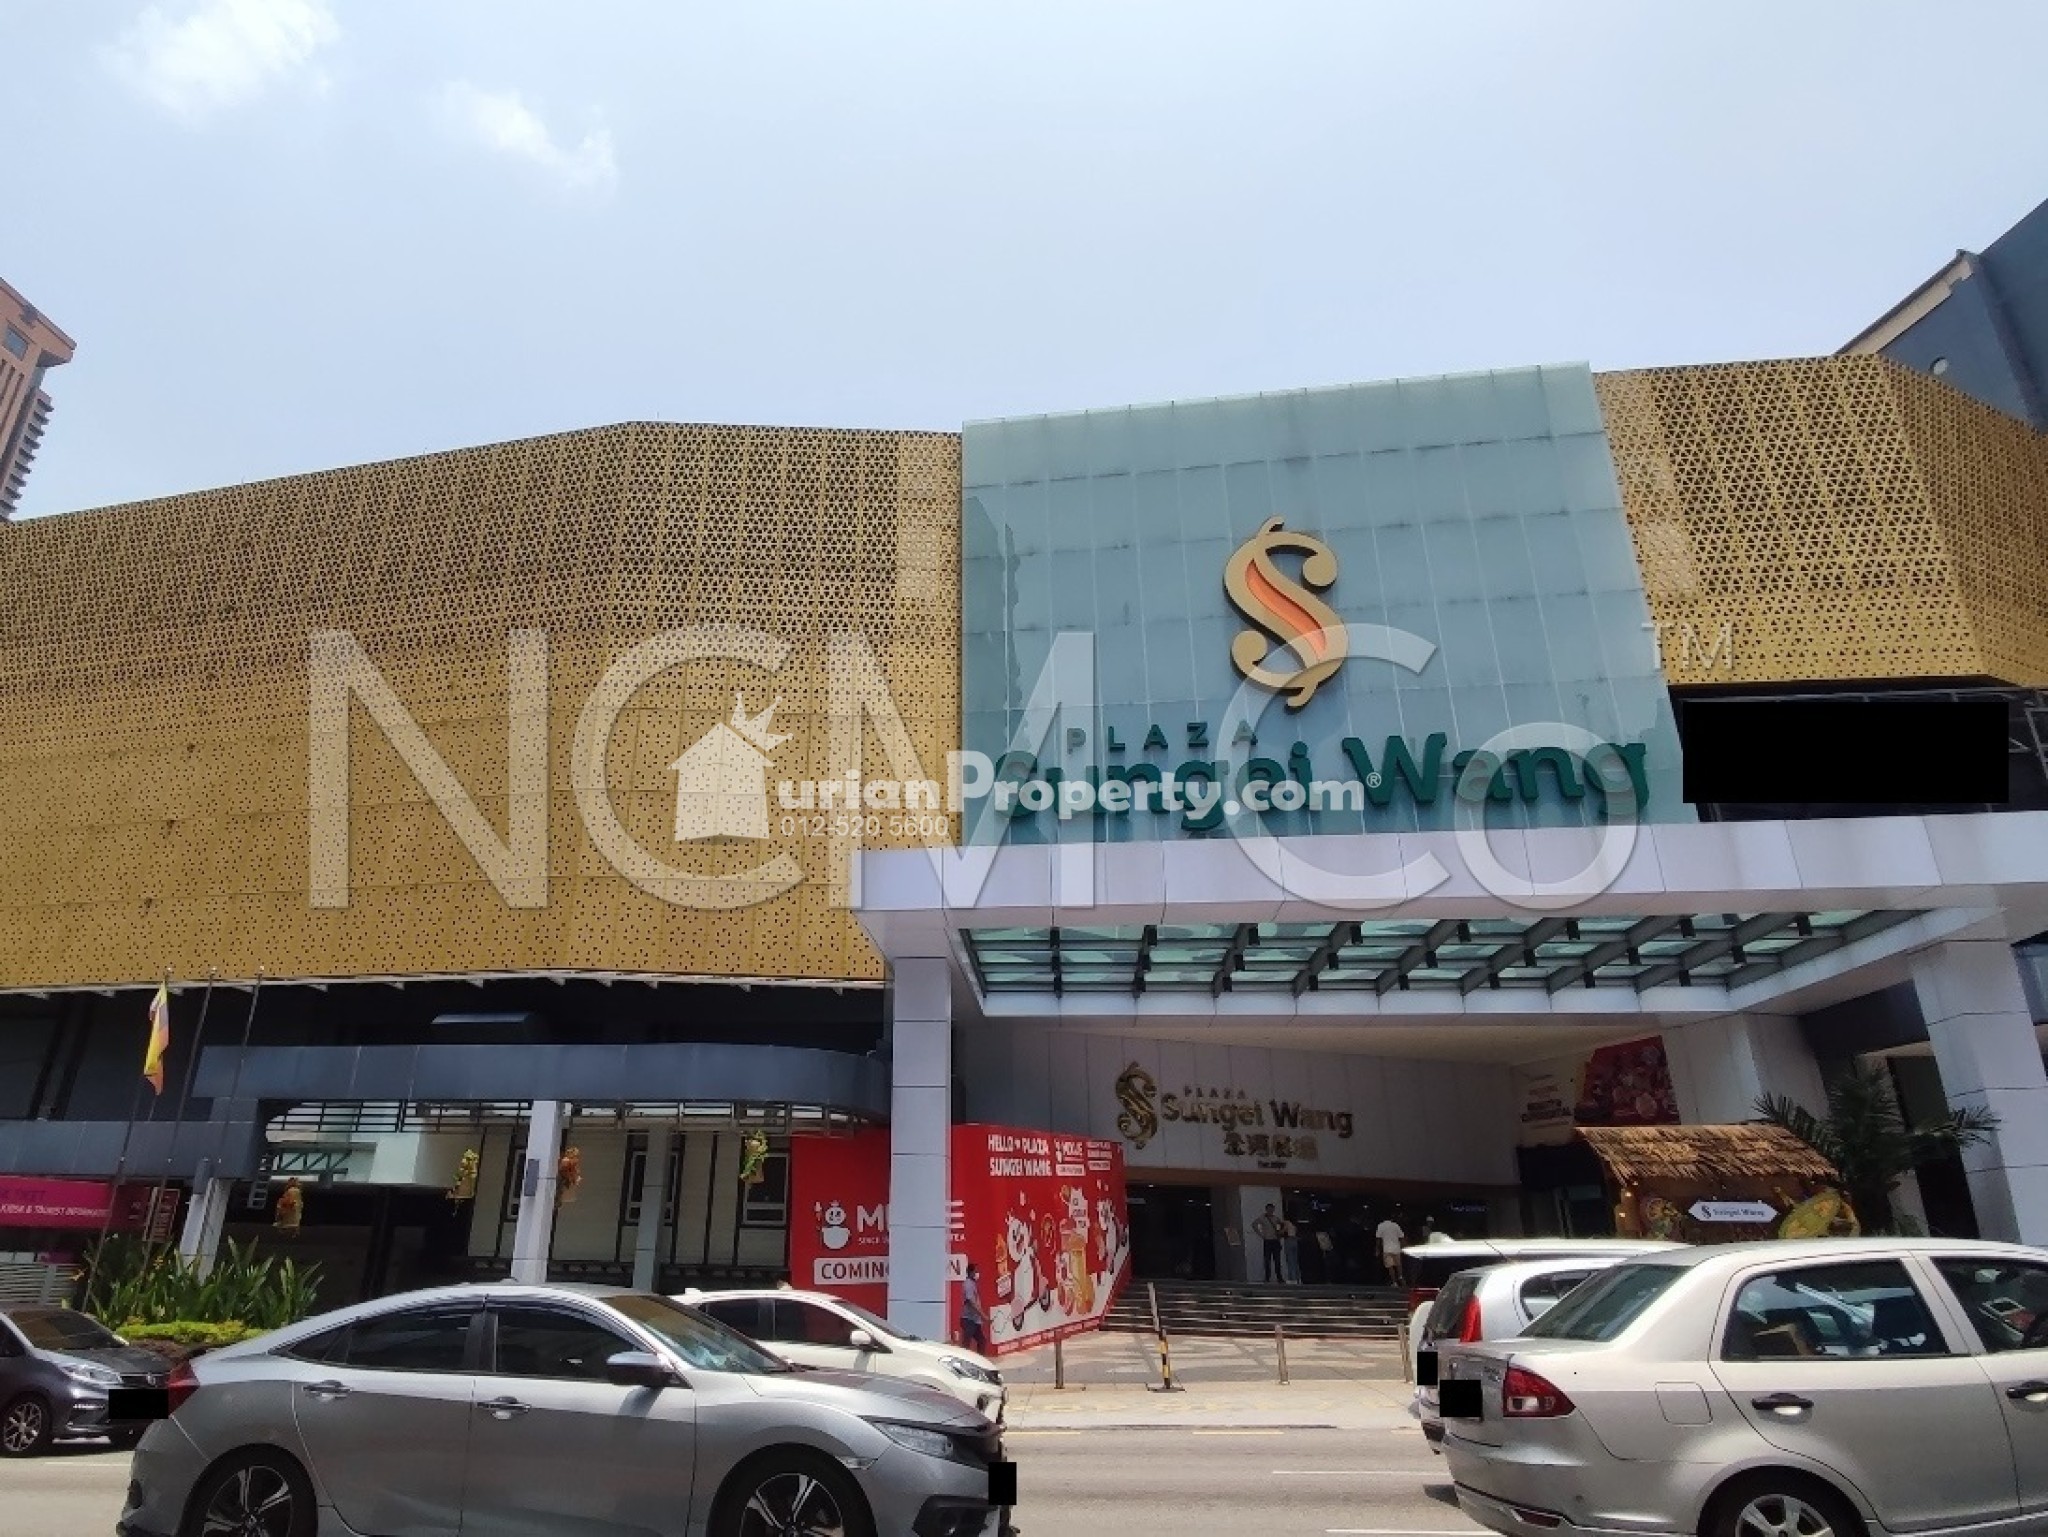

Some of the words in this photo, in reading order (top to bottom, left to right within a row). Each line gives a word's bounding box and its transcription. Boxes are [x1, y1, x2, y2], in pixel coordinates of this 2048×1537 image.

[1066, 720, 1258, 755] PLAZA
[996, 741, 1313, 831] Sungei
[1342, 732, 1650, 826] Wang
[1160, 1092, 1265, 1132] Sungei
[1268, 1098, 1355, 1138] Wang
[988, 1134, 1014, 1152] HELLO
[1022, 1137, 1049, 1155] PLAZA
[821, 1260, 890, 1279] COMIN
